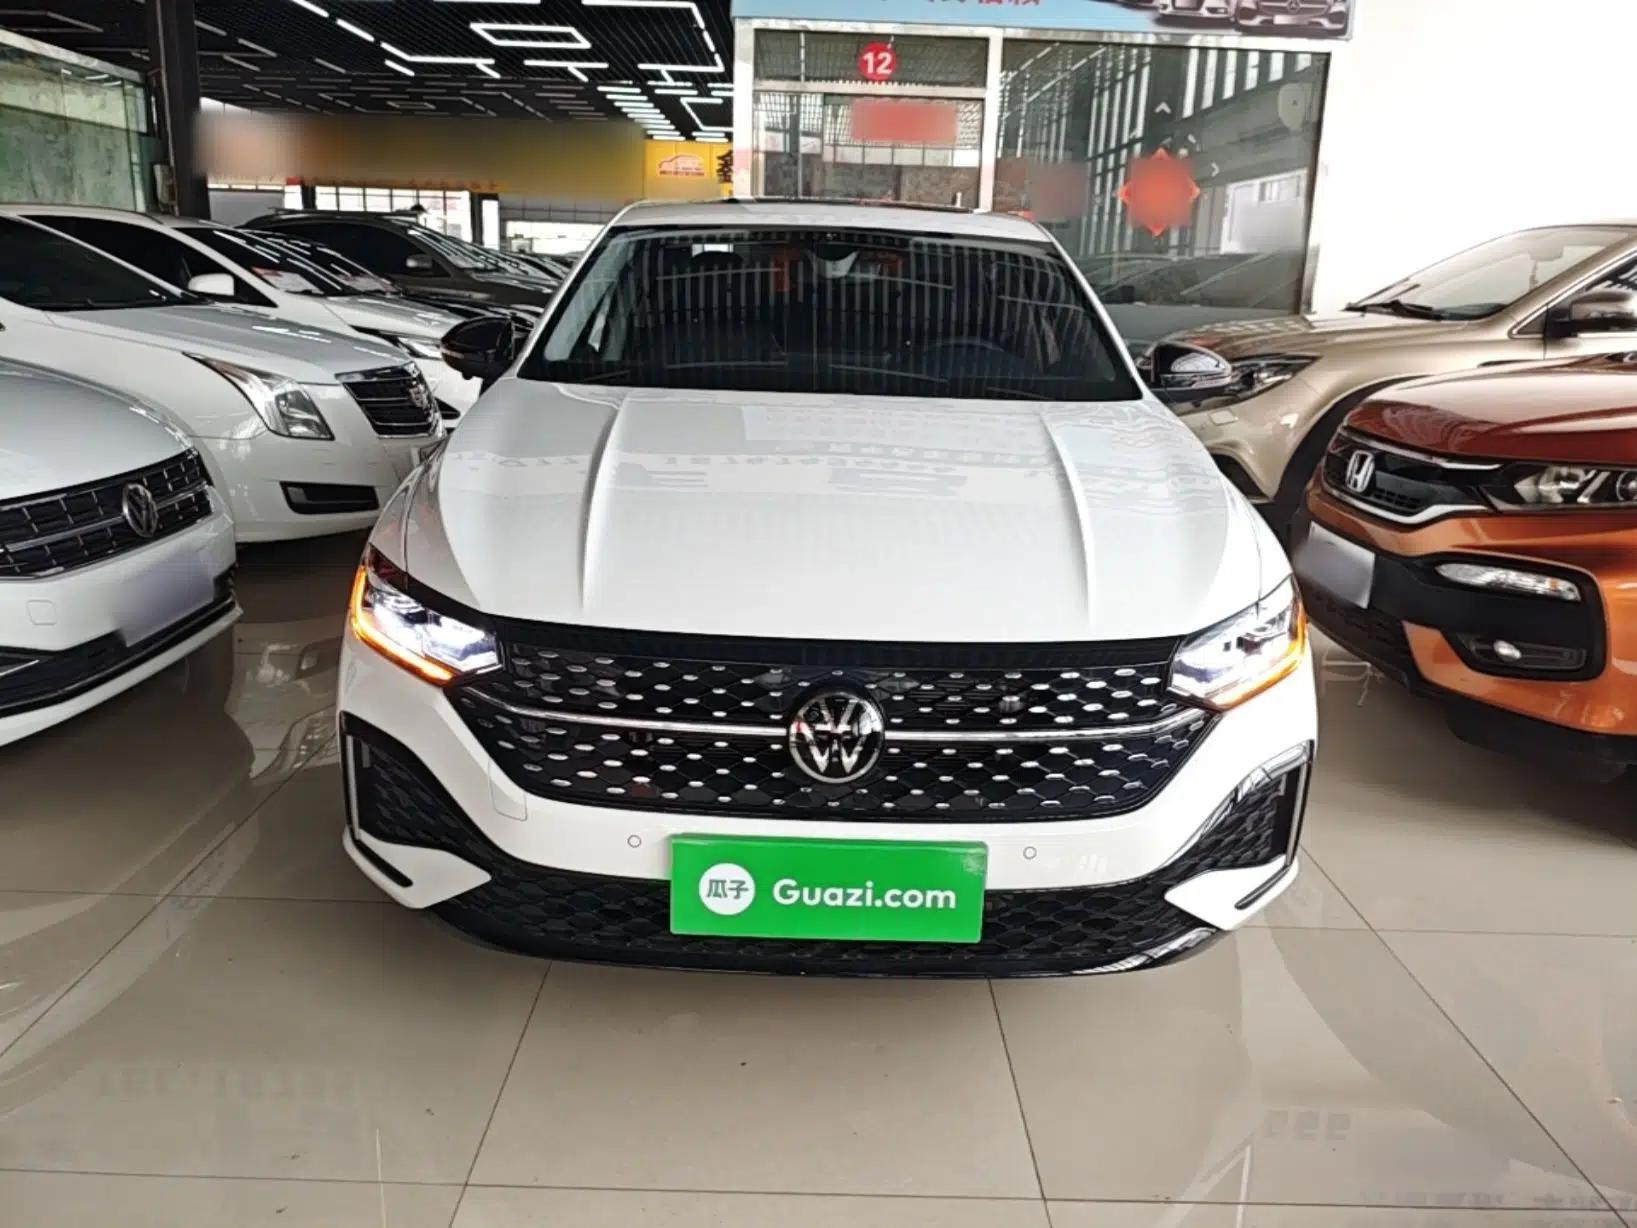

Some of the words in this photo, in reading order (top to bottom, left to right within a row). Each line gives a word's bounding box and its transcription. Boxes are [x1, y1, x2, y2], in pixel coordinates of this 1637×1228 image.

[863, 52, 892, 74] 12
[707, 879, 748, 899] 瓜子
[773, 879, 956, 909] Guazi.com
